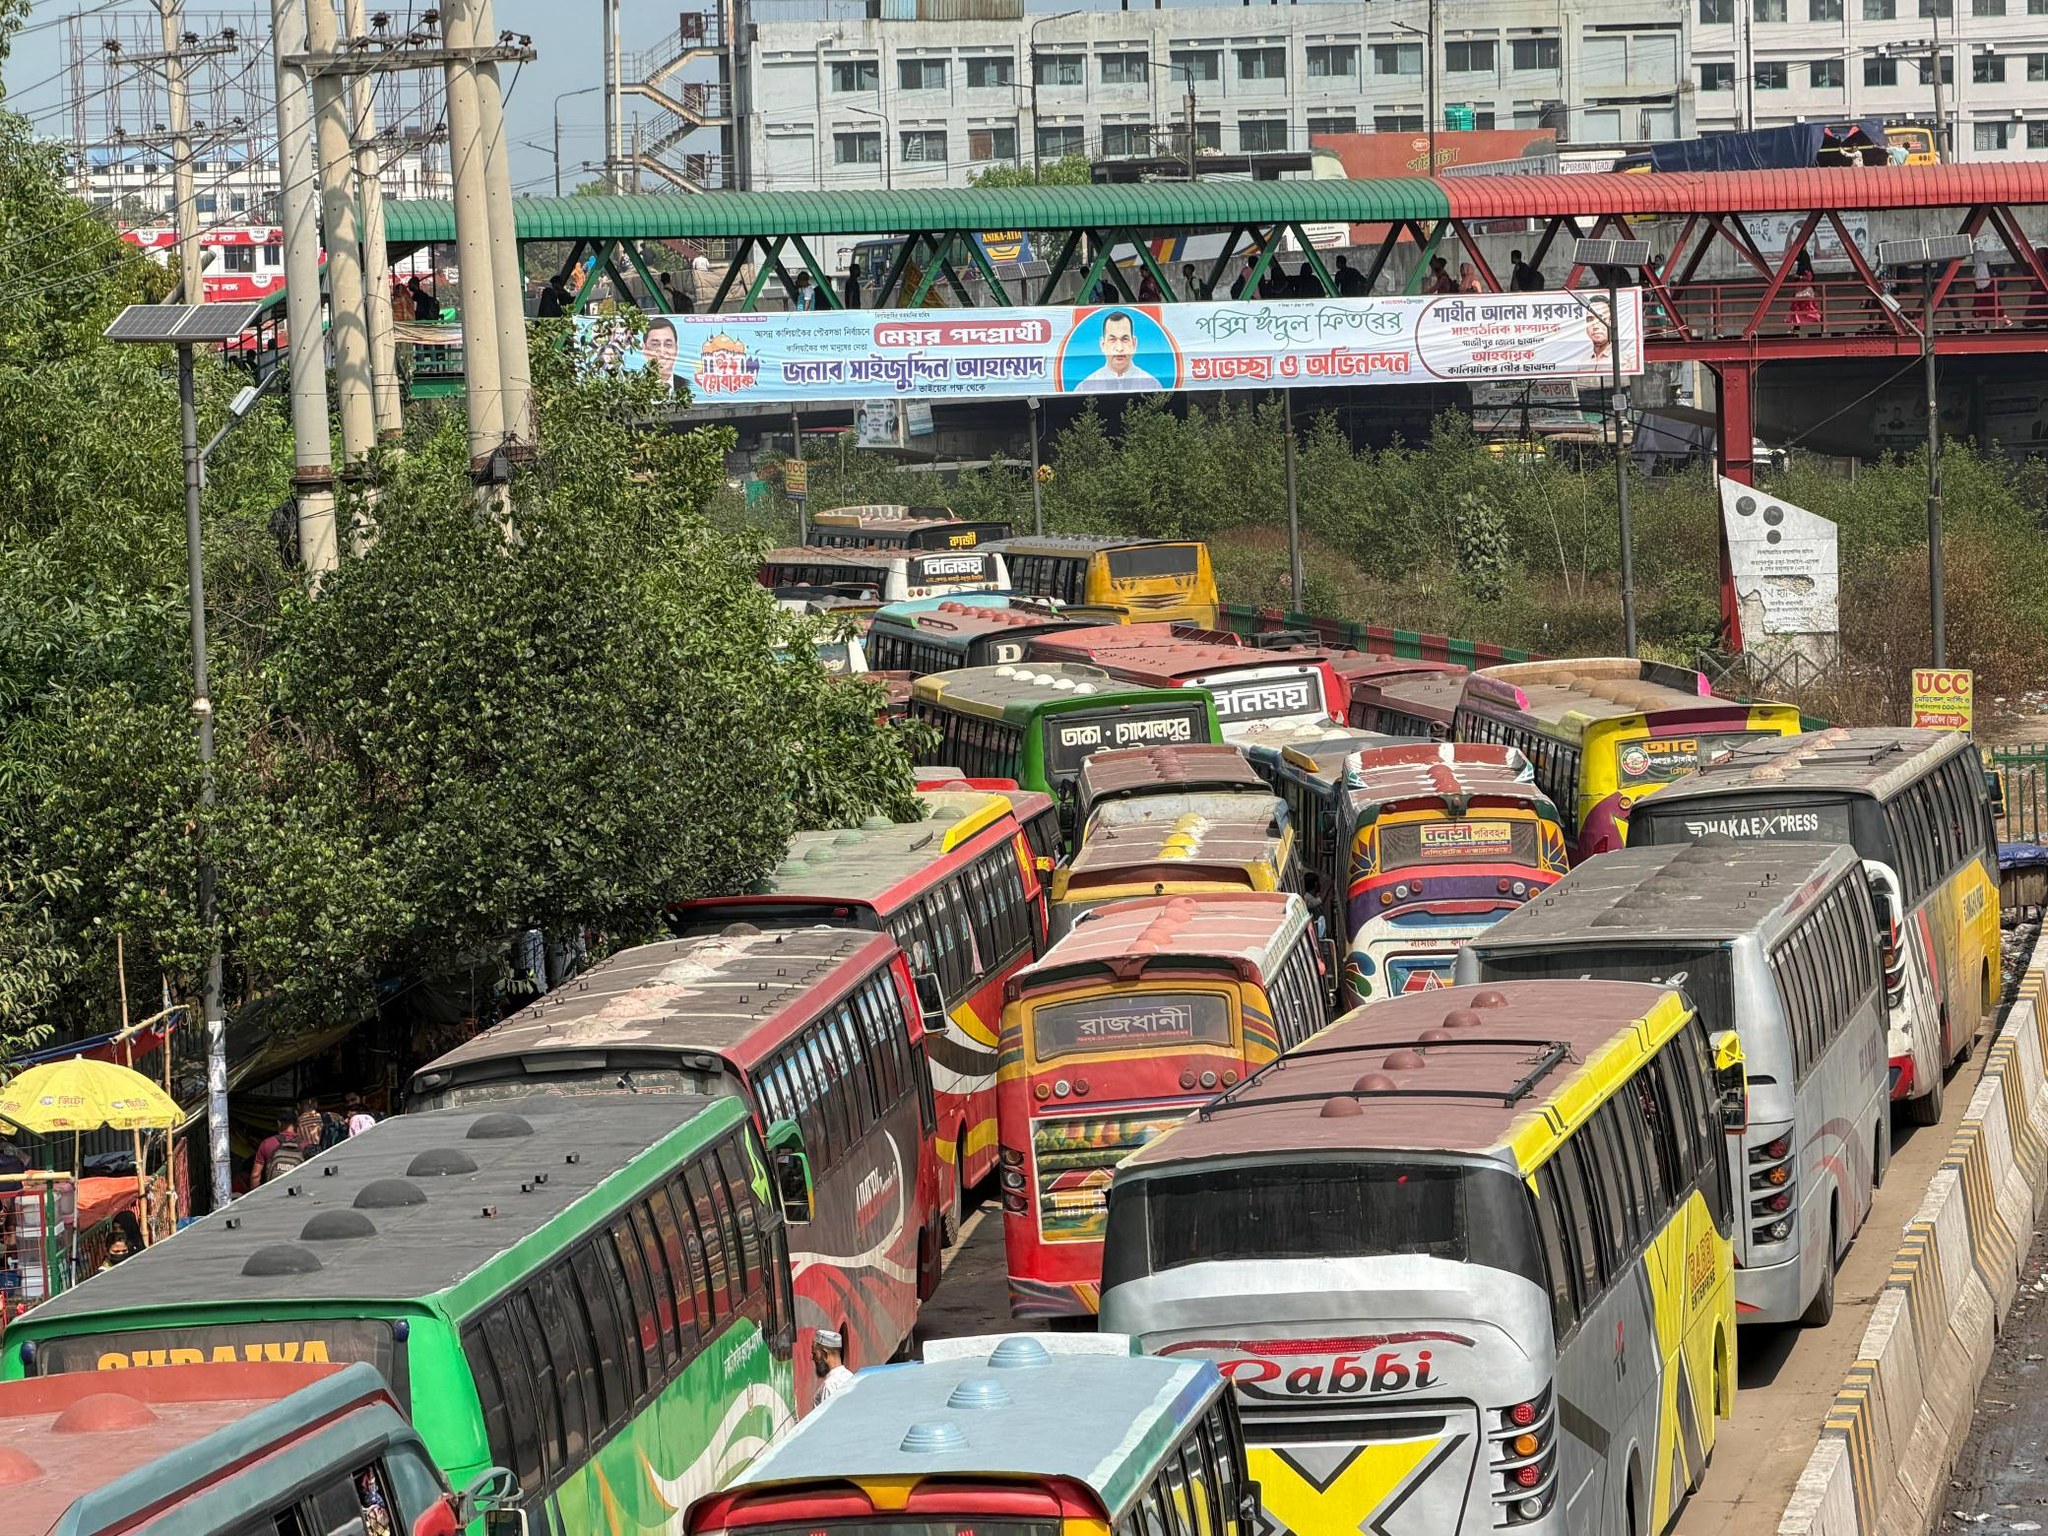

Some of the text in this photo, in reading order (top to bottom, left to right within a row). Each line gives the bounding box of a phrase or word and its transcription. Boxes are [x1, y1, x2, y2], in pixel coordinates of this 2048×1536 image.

[1597, 160, 1614, 171] GROU
[1433, 301, 1584, 323] শাহীন আলম সরকার
[879, 320, 1042, 347] মেয়র পদপ্রার্থী
[1196, 304, 1403, 351] পবিত্র ঈদুল ফিতরের
[782, 360, 843, 383] জনাব
[850, 351, 949, 390] সাইজুদ্দিন
[1191, 346, 1410, 380] শুভেচ্ছা ও অভিনন্দন
[950, 384, 964, 392] পক্ষ
[966, 383, 985, 392] থেকে
[1540, 384, 1572, 396] কাতার
[787, 463, 805, 473] UCC
[949, 531, 977, 546] কাজী
[923, 557, 983, 575] বিনিময়
[1916, 673, 1969, 694] UCC
[1061, 717, 1191, 746] ঢাকা গোপালপুর
[1473, 826, 1507, 839] পরিবহন
[1077, 1007, 1188, 1036] রাজধানী
[1217, 1351, 1448, 1400] Rabbi
